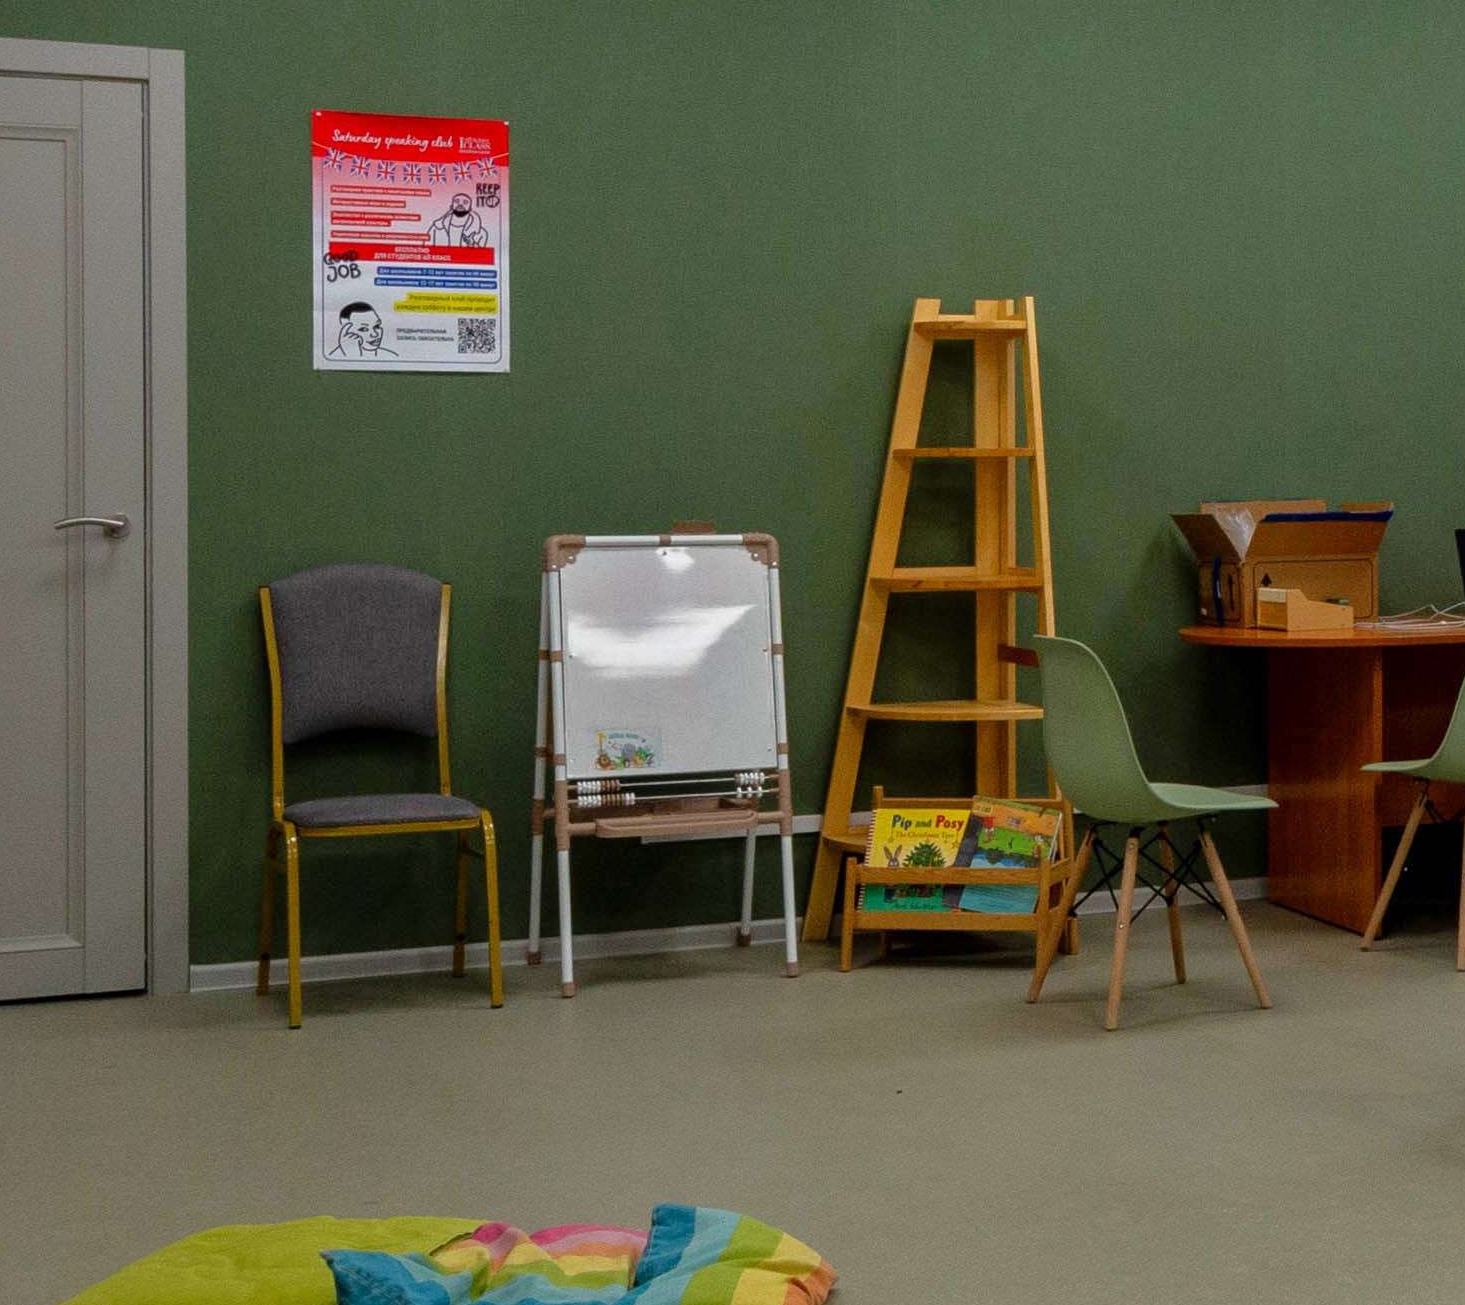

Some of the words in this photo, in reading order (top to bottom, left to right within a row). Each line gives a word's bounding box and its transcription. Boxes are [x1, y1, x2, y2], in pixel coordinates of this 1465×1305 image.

[332, 129, 382, 150] Saturday
[384, 135, 429, 152] speaking
[431, 136, 453, 147] club
[476, 183, 501, 195] KEEP
[327, 263, 361, 283] JOB
[892, 814, 912, 831] Pip
[935, 814, 965, 832] Posy
